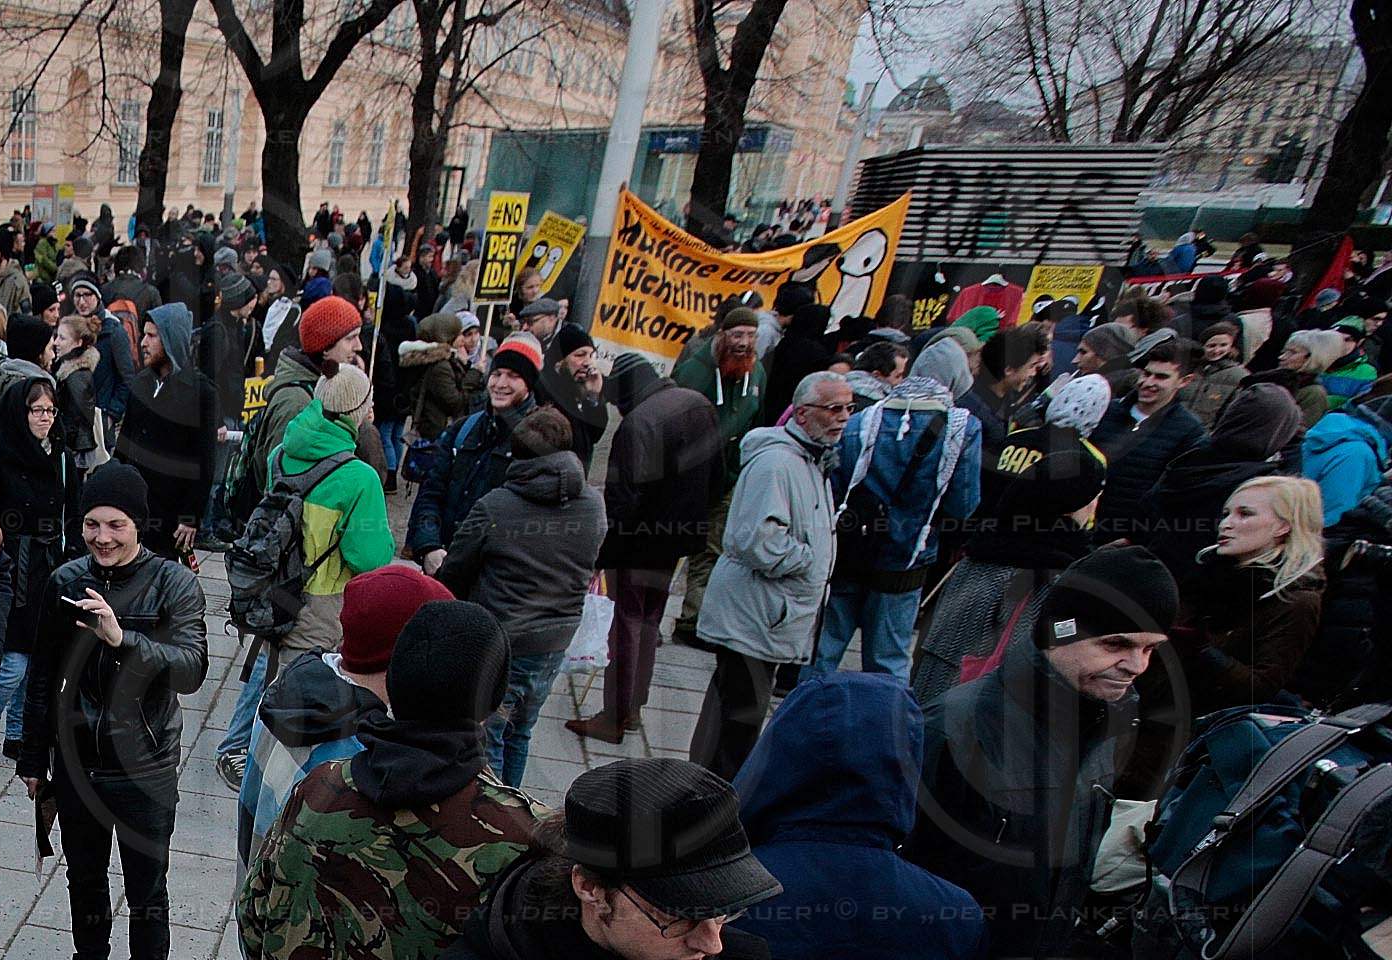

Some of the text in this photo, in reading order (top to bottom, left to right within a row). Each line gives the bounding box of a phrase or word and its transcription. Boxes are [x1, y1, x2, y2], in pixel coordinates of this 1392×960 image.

[491, 201, 523, 227] #NO
[487, 234, 517, 261] PEG
[481, 261, 511, 289] IDA
